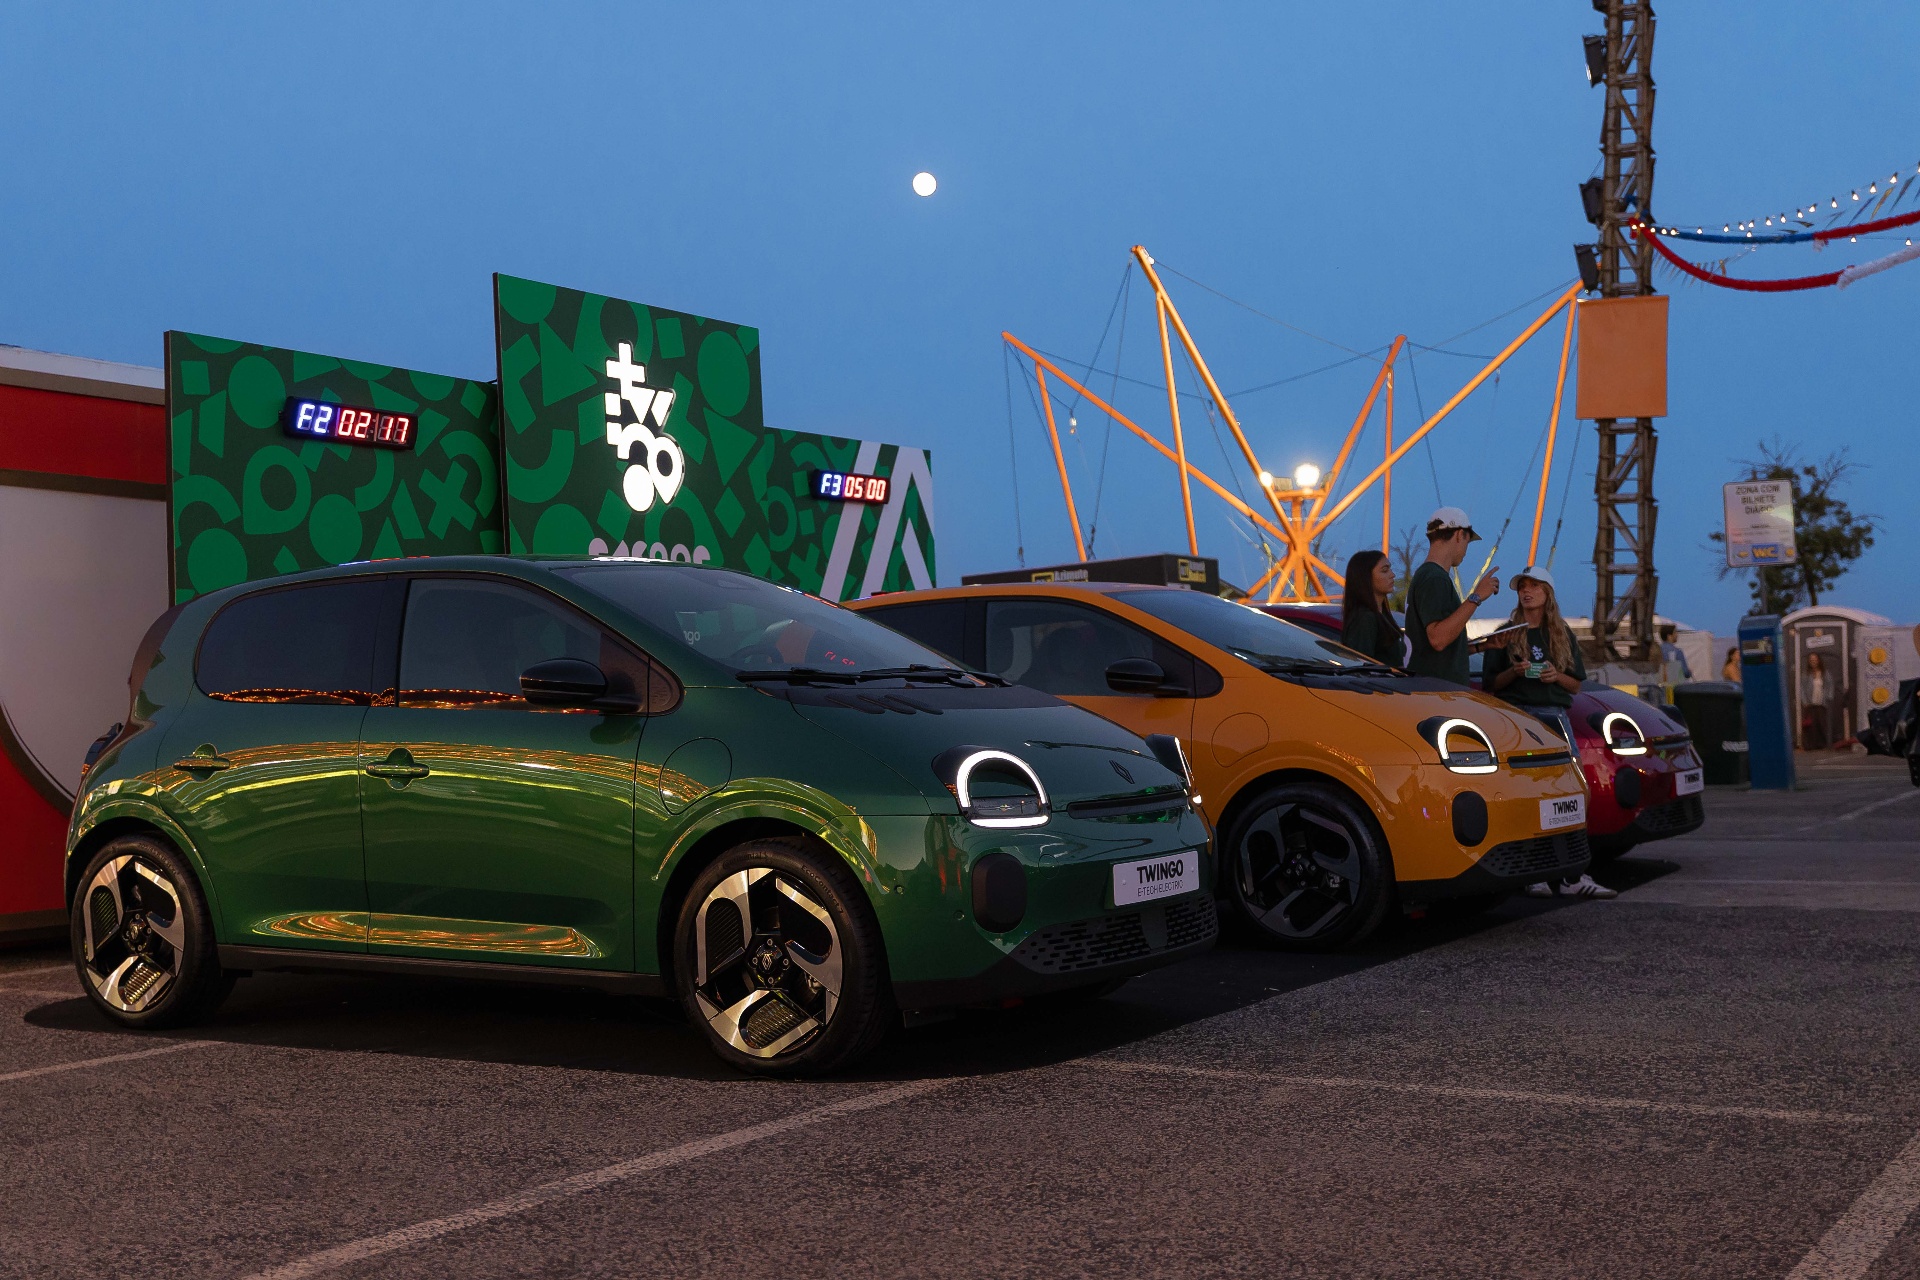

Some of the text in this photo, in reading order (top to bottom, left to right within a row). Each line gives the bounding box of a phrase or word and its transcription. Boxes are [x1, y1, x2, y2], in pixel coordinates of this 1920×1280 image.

[297, 403, 333, 433] F2
[820, 473, 842, 496] F3
[1552, 799, 1578, 815] TWINGO
[1136, 859, 1184, 884] TWINGO
[1137, 885, 1159, 897] E-TECH
